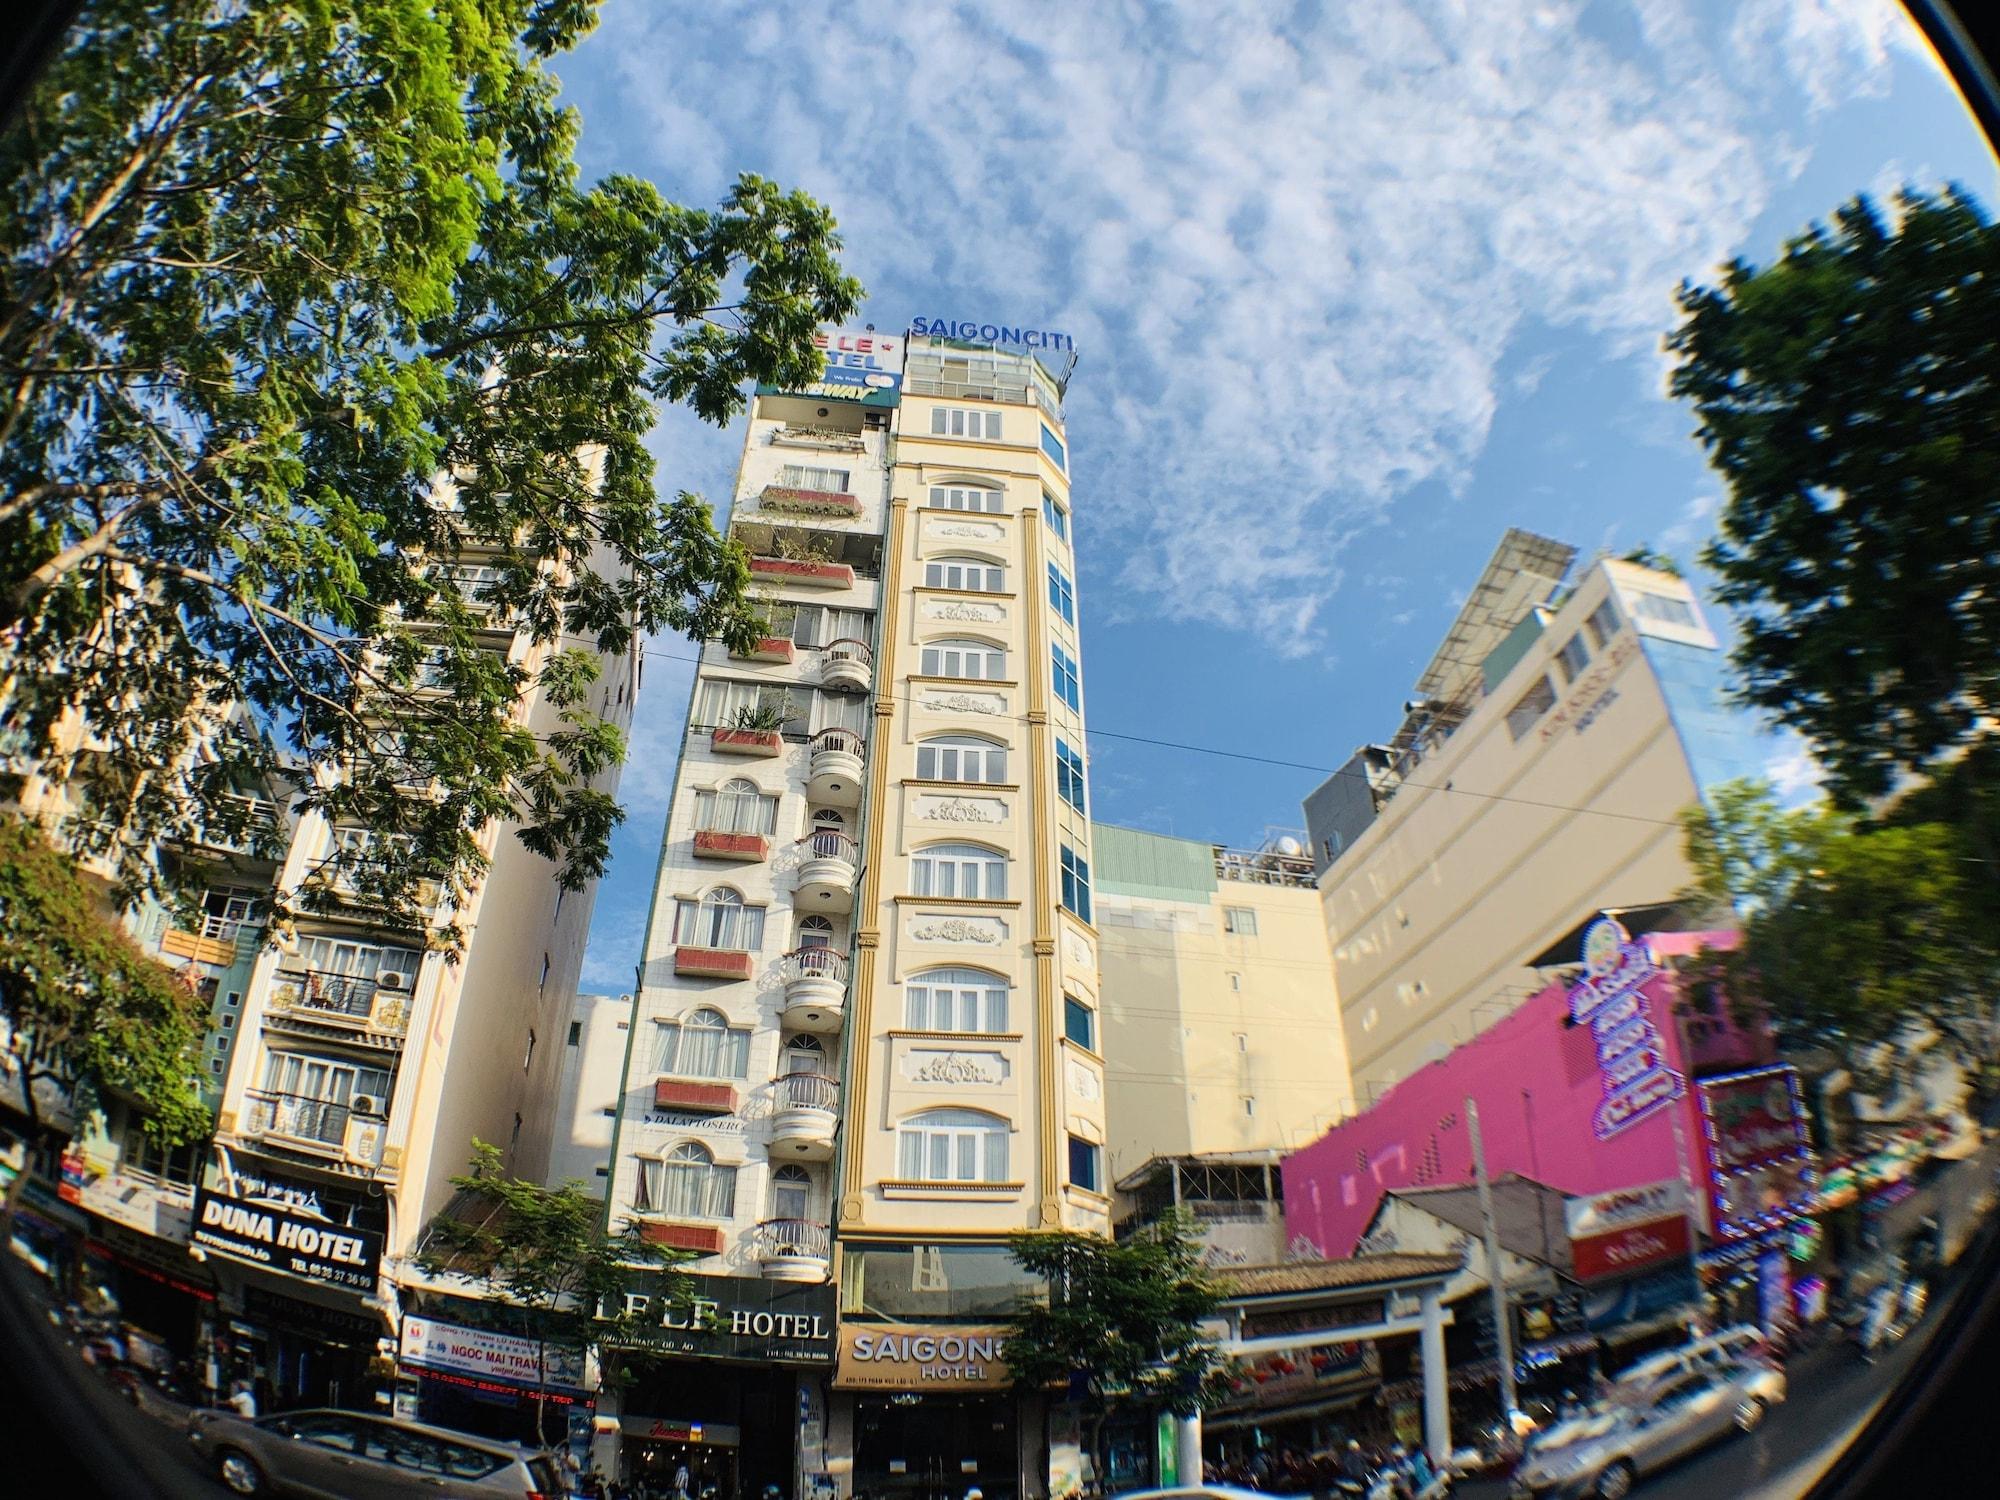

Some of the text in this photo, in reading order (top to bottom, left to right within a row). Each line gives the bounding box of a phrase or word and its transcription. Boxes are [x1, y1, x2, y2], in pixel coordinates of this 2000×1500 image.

[911, 316, 1074, 351] SAIGONCITI
[838, 336, 873, 353] LE
[826, 351, 882, 370] TEL
[202, 1199, 274, 1243] DUNA
[277, 1220, 367, 1267] HOTEL
[730, 1310, 830, 1339] HOTEL
[485, 1351, 506, 1365] MAI
[920, 1363, 989, 1381] HOTEL
